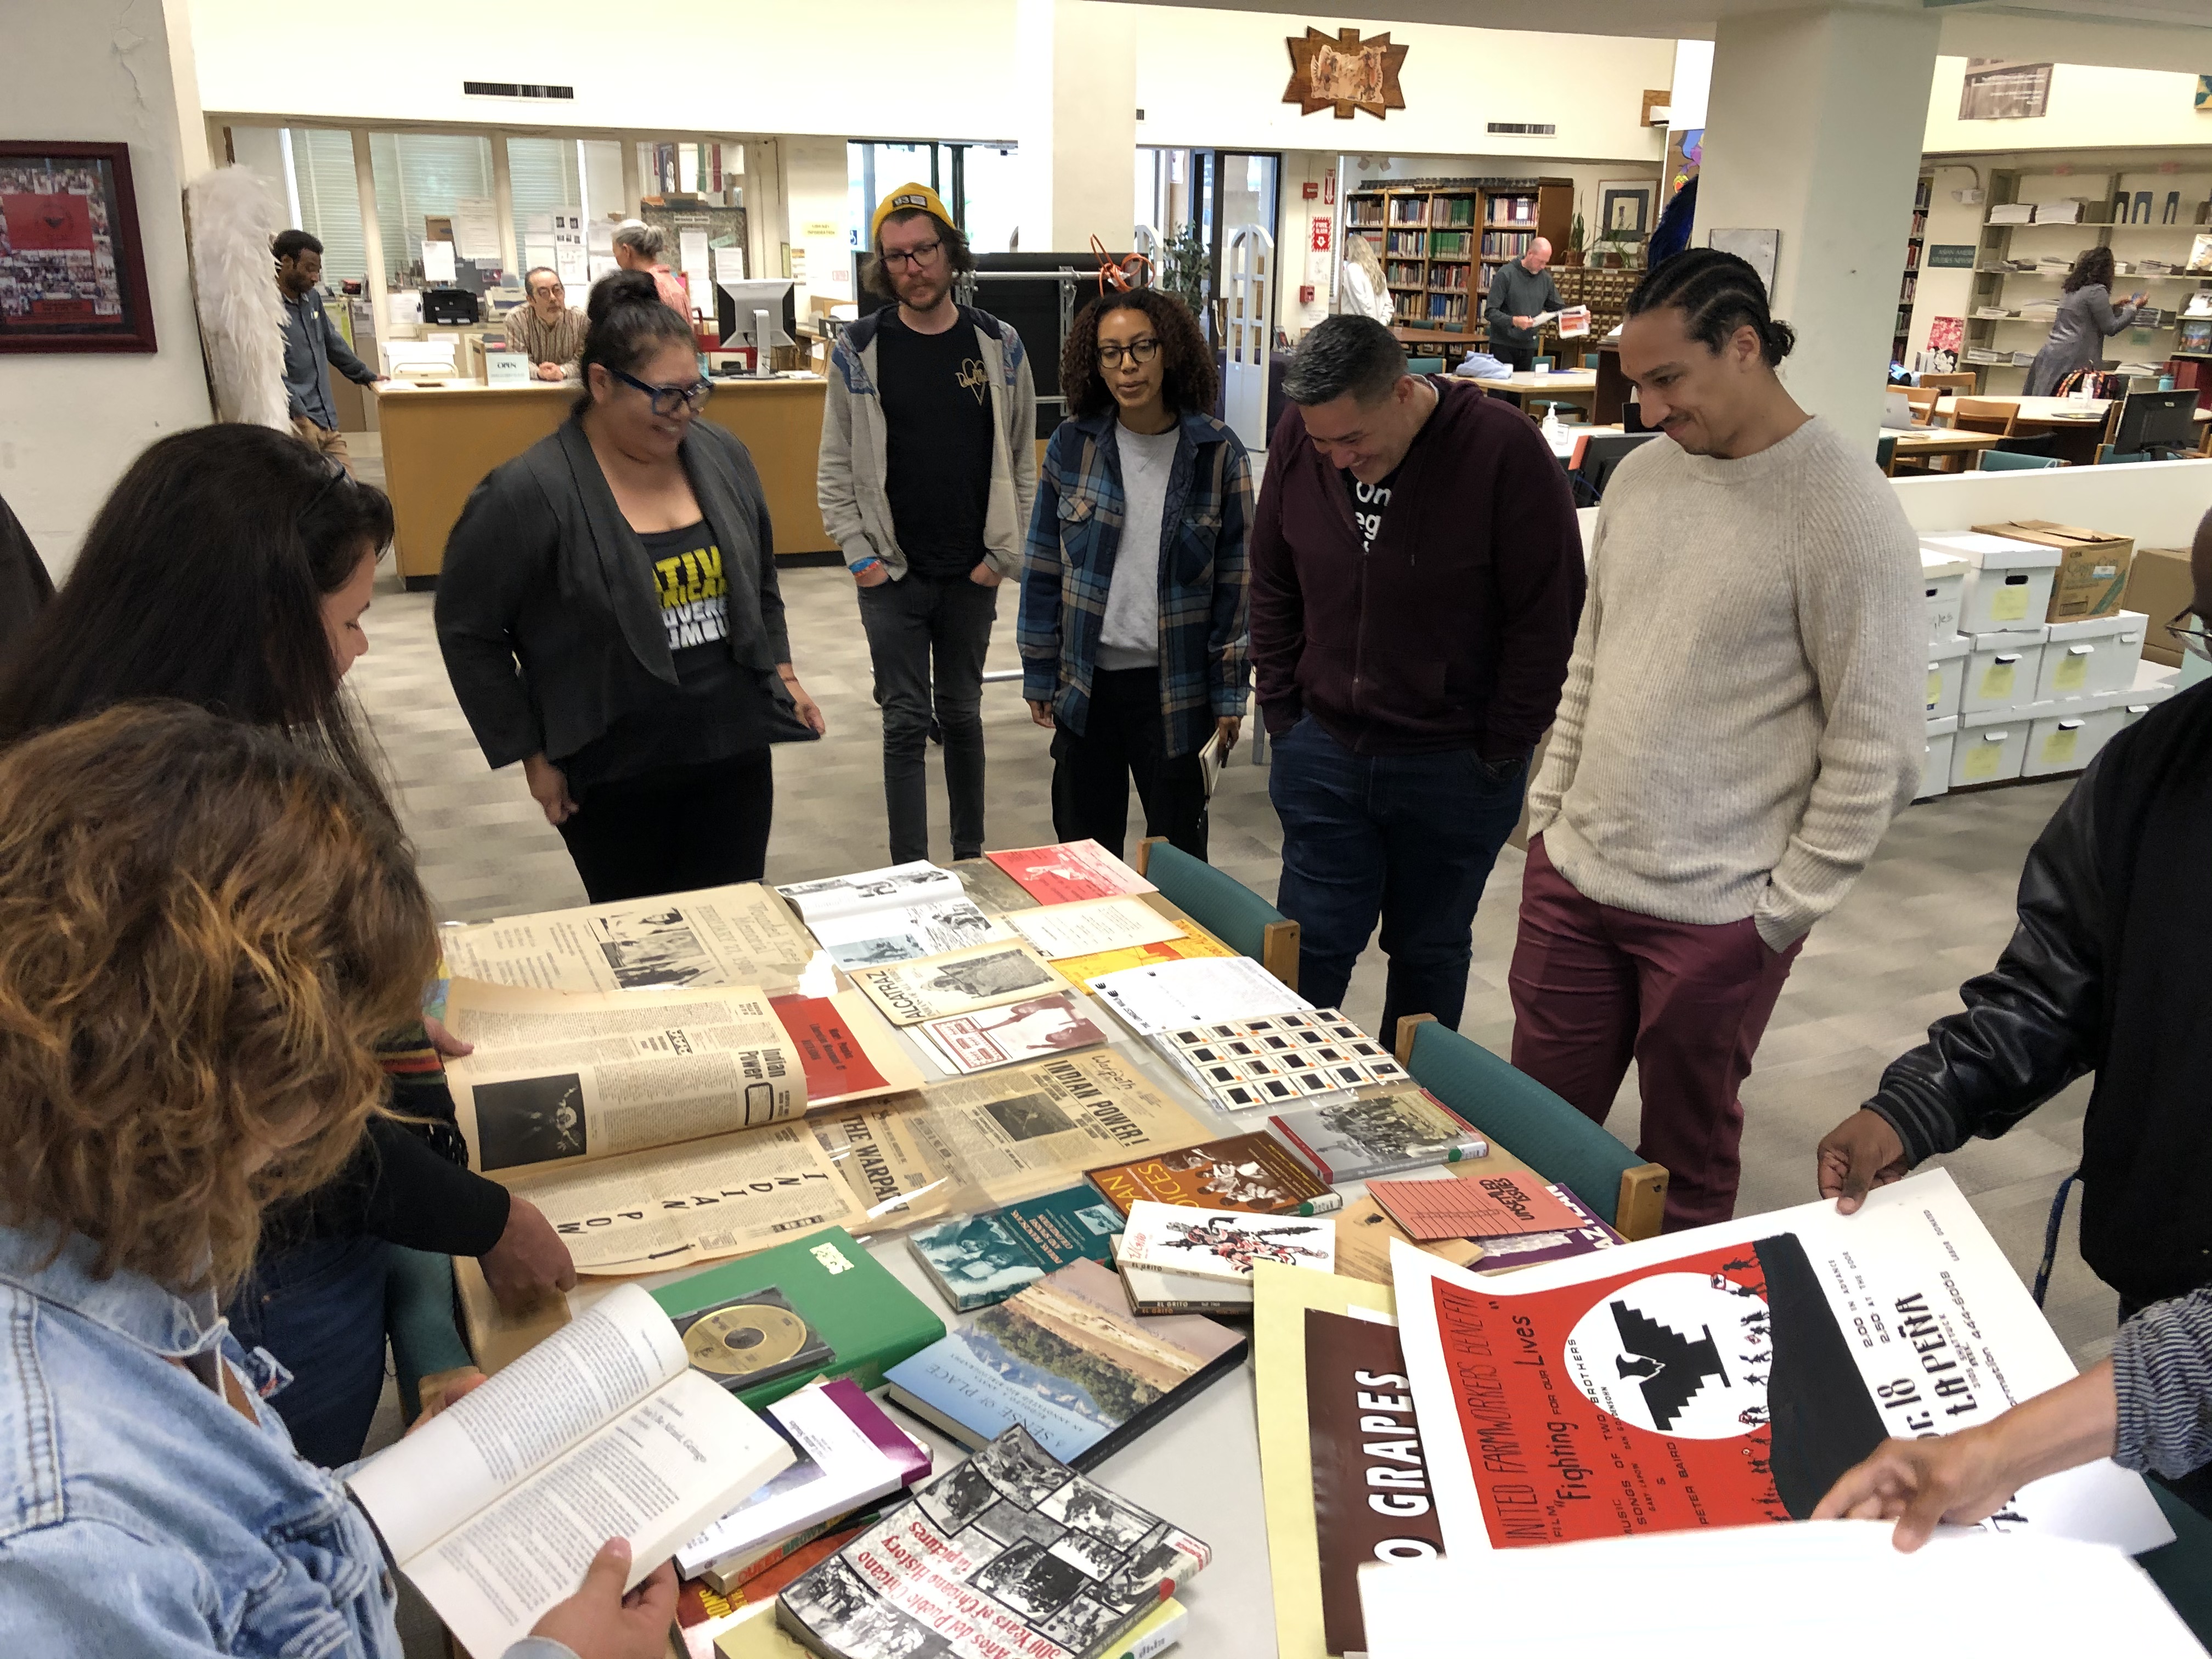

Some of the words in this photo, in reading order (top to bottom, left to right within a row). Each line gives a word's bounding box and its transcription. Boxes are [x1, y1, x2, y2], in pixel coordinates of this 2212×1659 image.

[865, 970, 926, 1019] ALCATRAZ
[738, 1051, 763, 1080] Power
[761, 1047, 786, 1077] Indian
[1091, 1054, 1136, 1092] Warpath
[1042, 1059, 1102, 1099] INDIAN
[1087, 1094, 1150, 1148] POWER!
[840, 1113, 872, 1146] THE
[1478, 1178, 1536, 1222] UNSETTLED
[1141, 1263, 1163, 1272] GRITO
[1829, 1259, 1850, 1294] ADVANCE
[1842, 1251, 1857, 1269] DOOR
[1854, 1274, 1866, 1290] THE
[1865, 1296, 1875, 1307] AT
[1440, 1288, 1493, 1357] BENEFIT
[1853, 1317, 1874, 1348] 2.00
[1870, 1312, 1891, 1344] 2.50
[1894, 1291, 1957, 1375] PEÑA
[924, 1361, 979, 1399] PLACE
[1538, 1368, 1554, 1391] OUR
[1567, 1339, 1600, 1404] BROTHERS
[1547, 1392, 1562, 1416] FOR
[1877, 1377, 1922, 1409] 18
[998, 1404, 1054, 1442] SENSE
[1457, 1361, 1528, 1474] FARMWORKERS
[1596, 1413, 1613, 1441] TWO
[1355, 1370, 1430, 1517] GRAPES
[1610, 1452, 1624, 1469] OF
[1666, 1441, 1689, 1479] BAIRD
[1621, 1480, 1648, 1526] SONGS
[1684, 1485, 1710, 1525] PETER
[1546, 1505, 1563, 1538] FILM
[879, 1534, 928, 1582] History
[907, 1520, 960, 1565] pictures
[737, 1547, 783, 1583] QUEER
[856, 1549, 909, 1602] Chicano
[951, 1556, 970, 1577] in
[903, 1590, 952, 1631] Pueblo
[925, 1572, 979, 1613] Chicano
[947, 1618, 973, 1643] del
[972, 1601, 995, 1624] of
[969, 1631, 1010, 1659] Años
[990, 1613, 1032, 1649] Years
